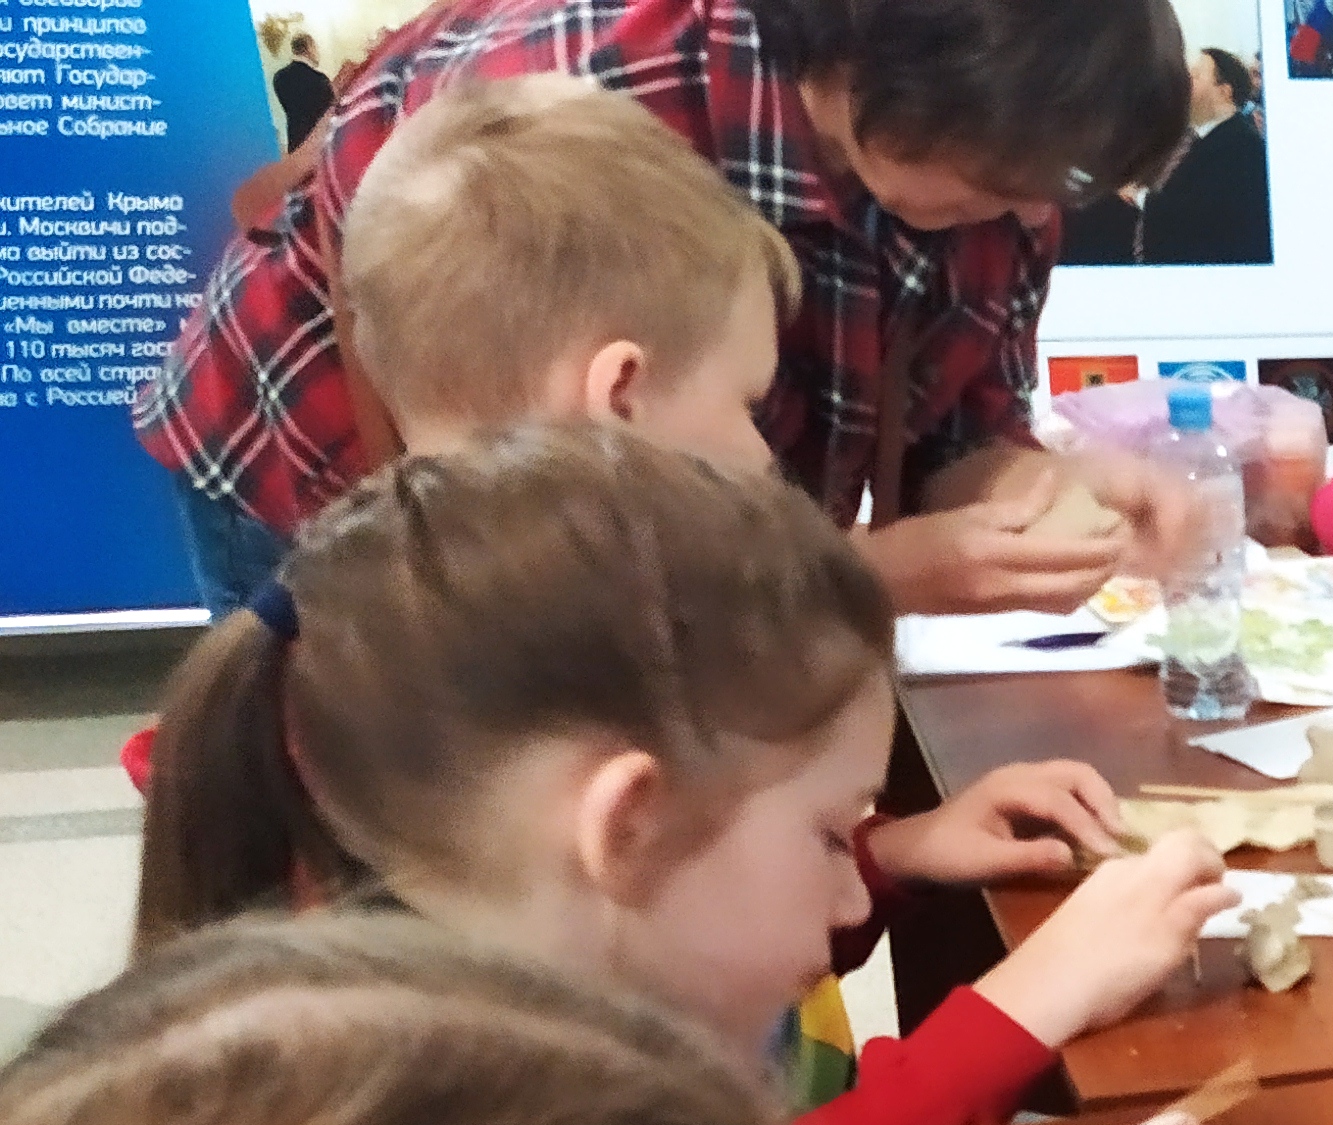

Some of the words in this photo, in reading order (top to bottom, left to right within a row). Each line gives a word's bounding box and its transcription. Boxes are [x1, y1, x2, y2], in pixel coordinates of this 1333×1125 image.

[23, 17, 147, 36] принципов
[56, 64, 156, 89] Государ-
[62, 95, 162, 110] минист-
[58, 116, 167, 139] Собрание
[108, 192, 183, 214] Крыма
[19, 217, 130, 236] Москвичи
[137, 215, 187, 236] под-
[27, 242, 107, 260] выйти
[113, 246, 139, 260] из
[129, 265, 196, 284] Феде-
[99, 293, 171, 309] почти
[4, 316, 54, 334] «Мы
[67, 318, 166, 334] вместе»
[6, 340, 46, 359] 110
[51, 343, 125, 358] тысяч
[2, 364, 32, 382] По
[40, 361, 91, 382] всей
